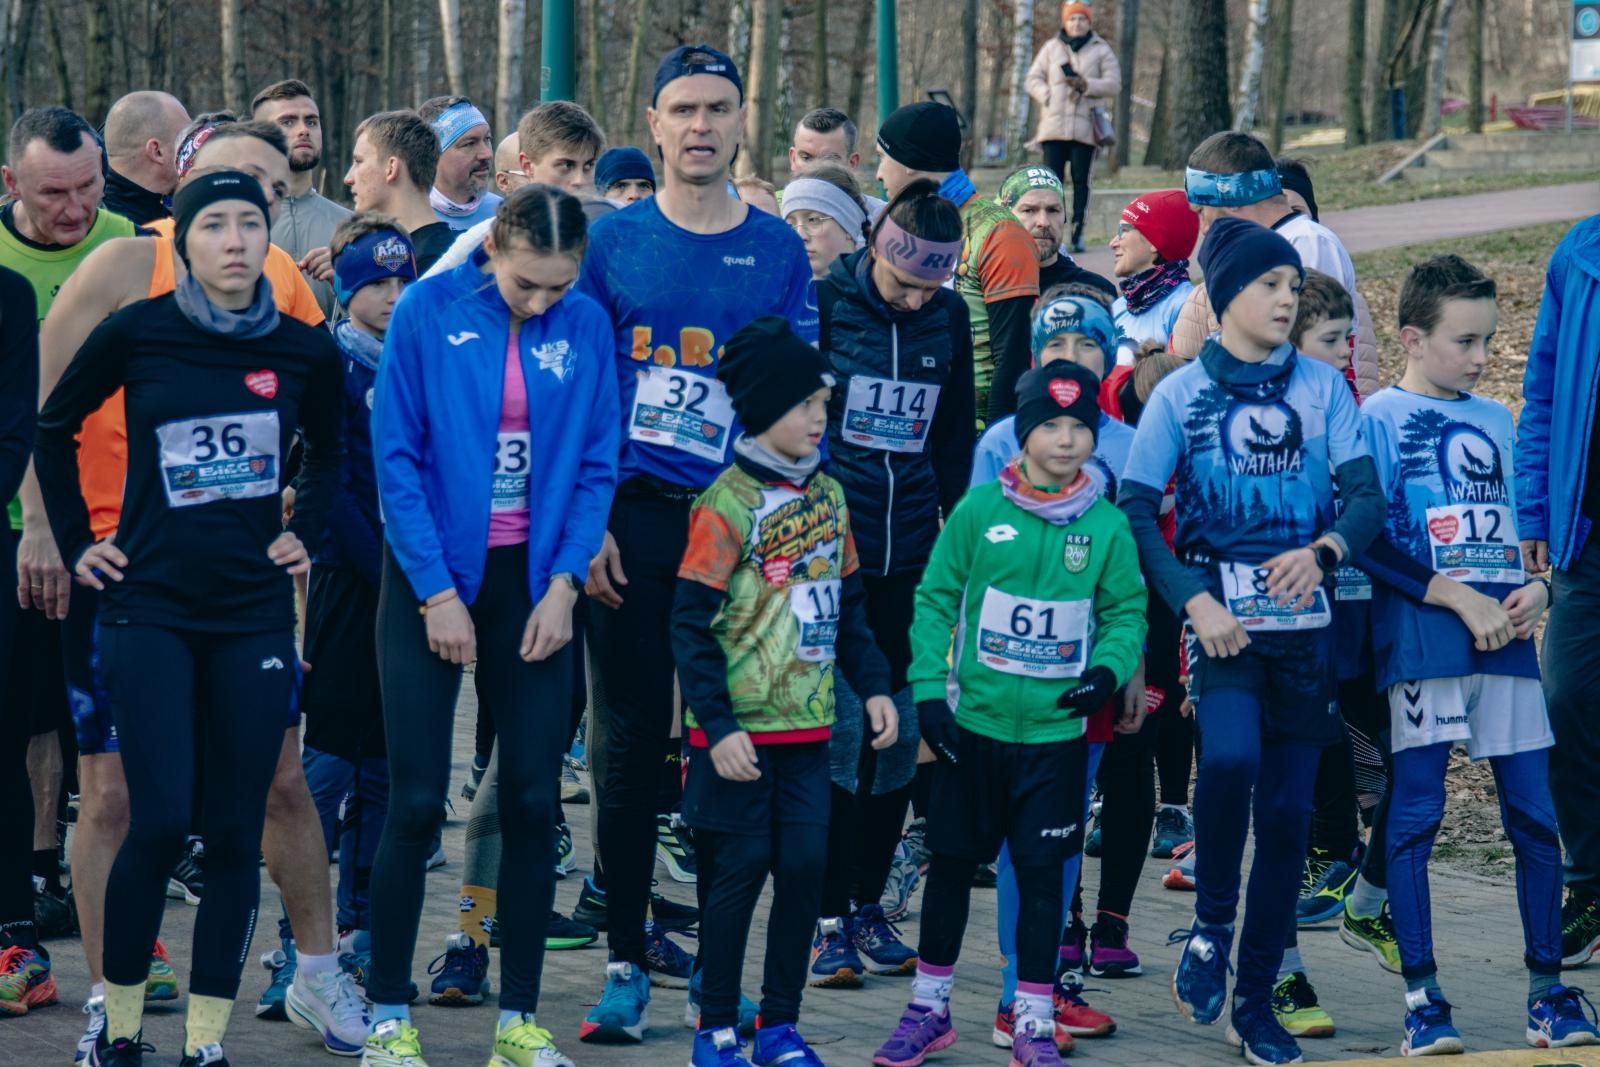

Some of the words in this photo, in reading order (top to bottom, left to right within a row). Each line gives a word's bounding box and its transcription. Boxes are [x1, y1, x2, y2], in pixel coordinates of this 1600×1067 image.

[1045, 318, 1080, 335] WATAHA
[664, 375, 710, 416] 32
[865, 382, 927, 418] 114
[192, 423, 247, 462] 36
[1231, 448, 1301, 476] WATAHA
[1449, 479, 1509, 504] WATAHA
[1067, 535, 1090, 544] RKP
[1462, 509, 1503, 543] 12
[808, 585, 841, 620] 11
[1010, 604, 1058, 640] 61
[1435, 714, 1469, 726] humme
